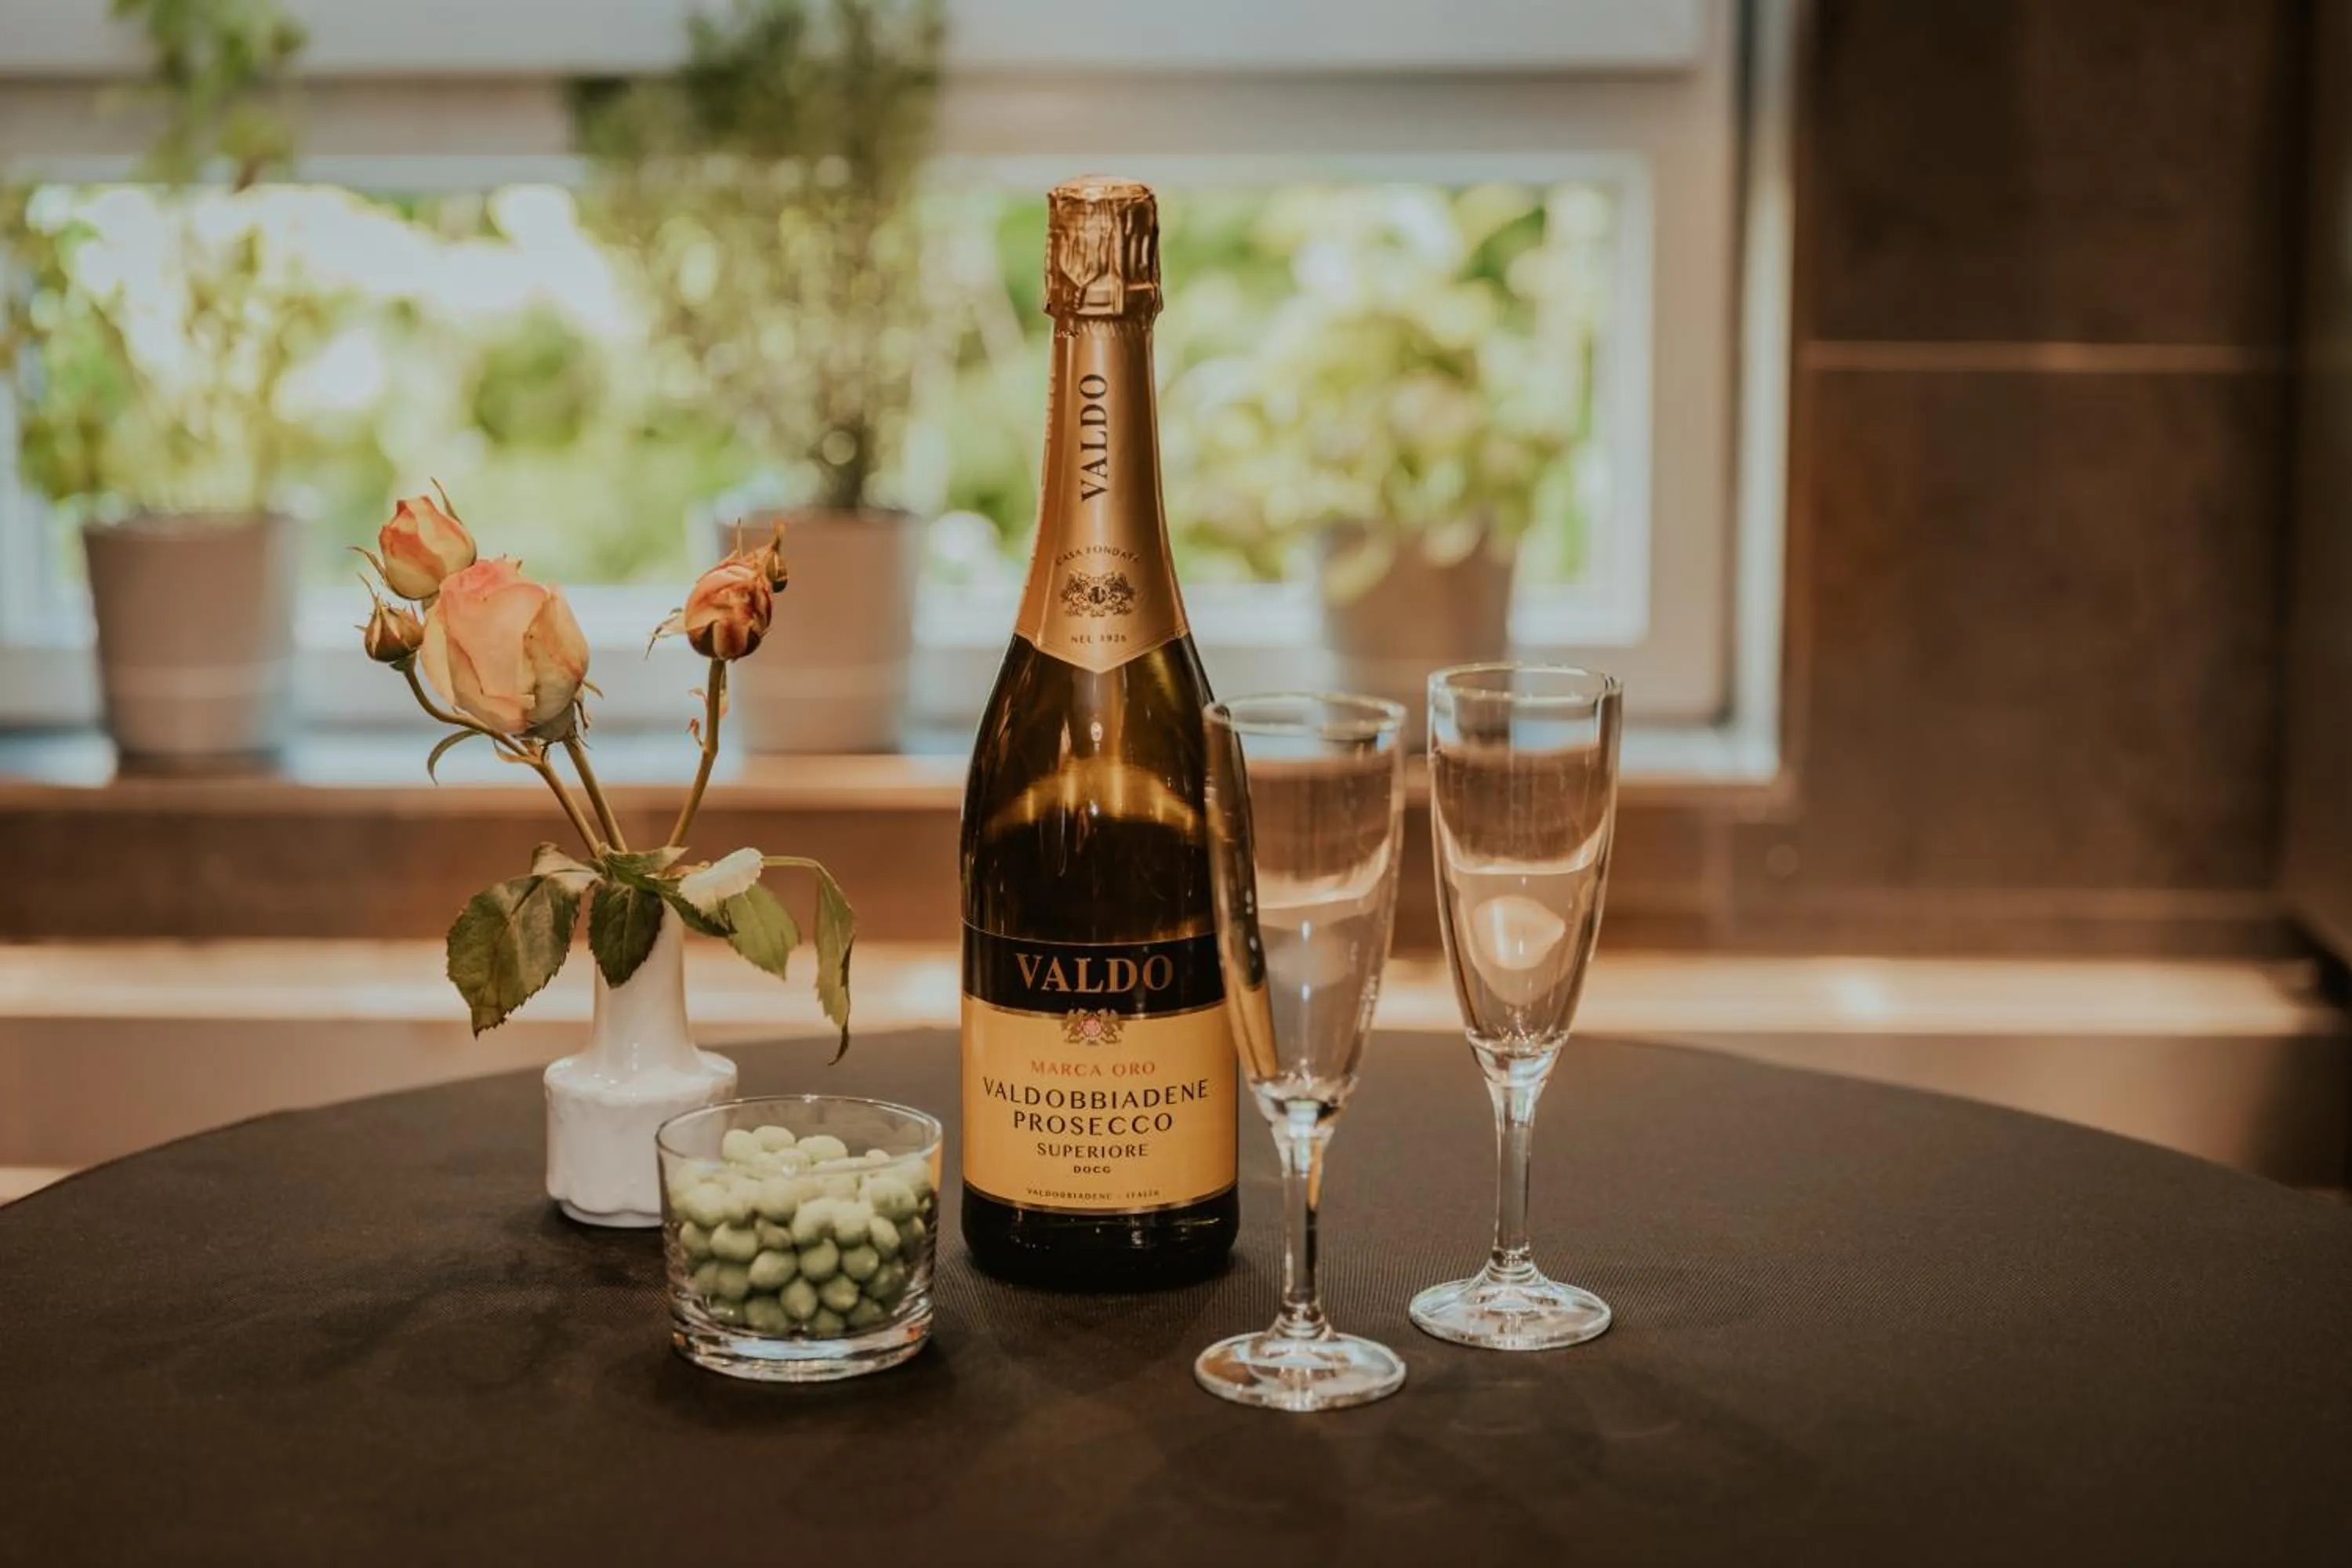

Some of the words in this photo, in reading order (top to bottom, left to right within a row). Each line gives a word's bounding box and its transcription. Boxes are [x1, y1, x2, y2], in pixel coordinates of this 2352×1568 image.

[1079, 374, 1108, 502] VALDO
[1016, 953, 1174, 993] VALDO
[1031, 1060, 1102, 1077] MARCA
[1112, 1062, 1156, 1077] ORO
[983, 1077, 1209, 1110] VALDOBBIADENE
[1014, 1111, 1173, 1136] PROSECCO
[1037, 1142, 1149, 1159] SUPERIORE
